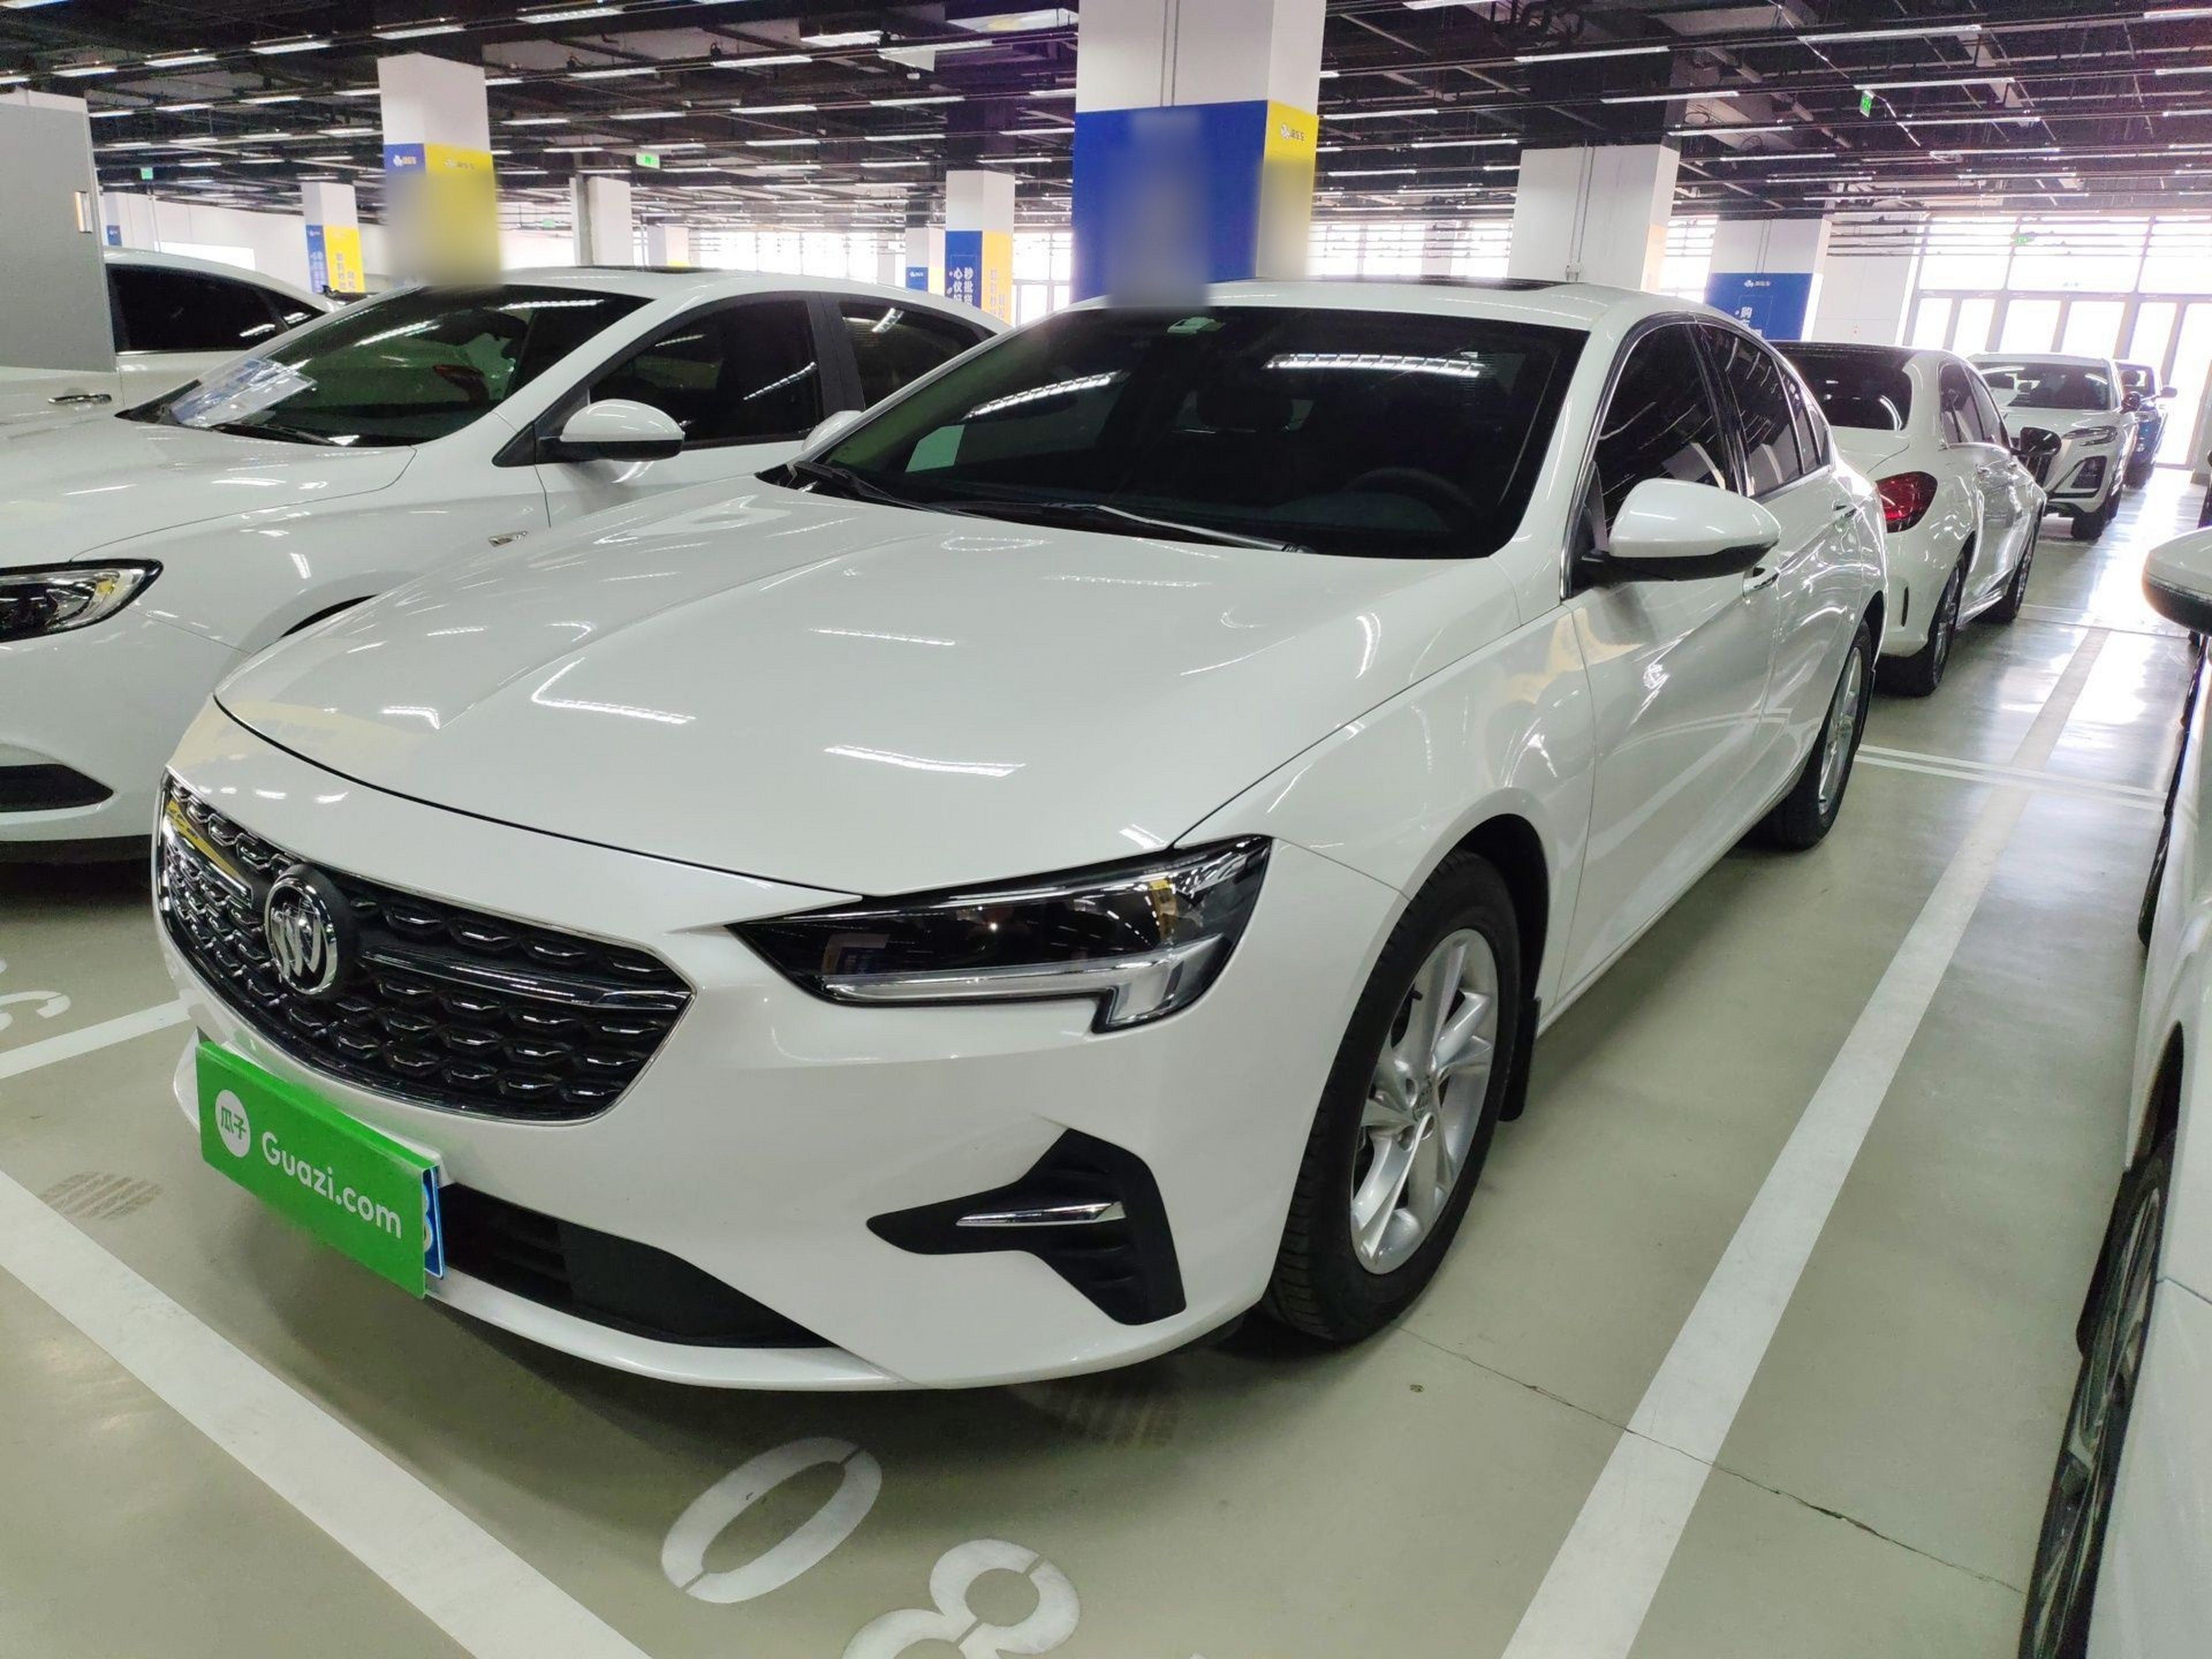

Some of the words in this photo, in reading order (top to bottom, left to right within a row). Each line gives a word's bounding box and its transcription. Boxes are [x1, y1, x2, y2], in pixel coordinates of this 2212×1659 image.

[220, 1105, 247, 1141] 瓜子
[262, 1131, 402, 1239] Guazi.com
[661, 1436, 1207, 1659] 08
